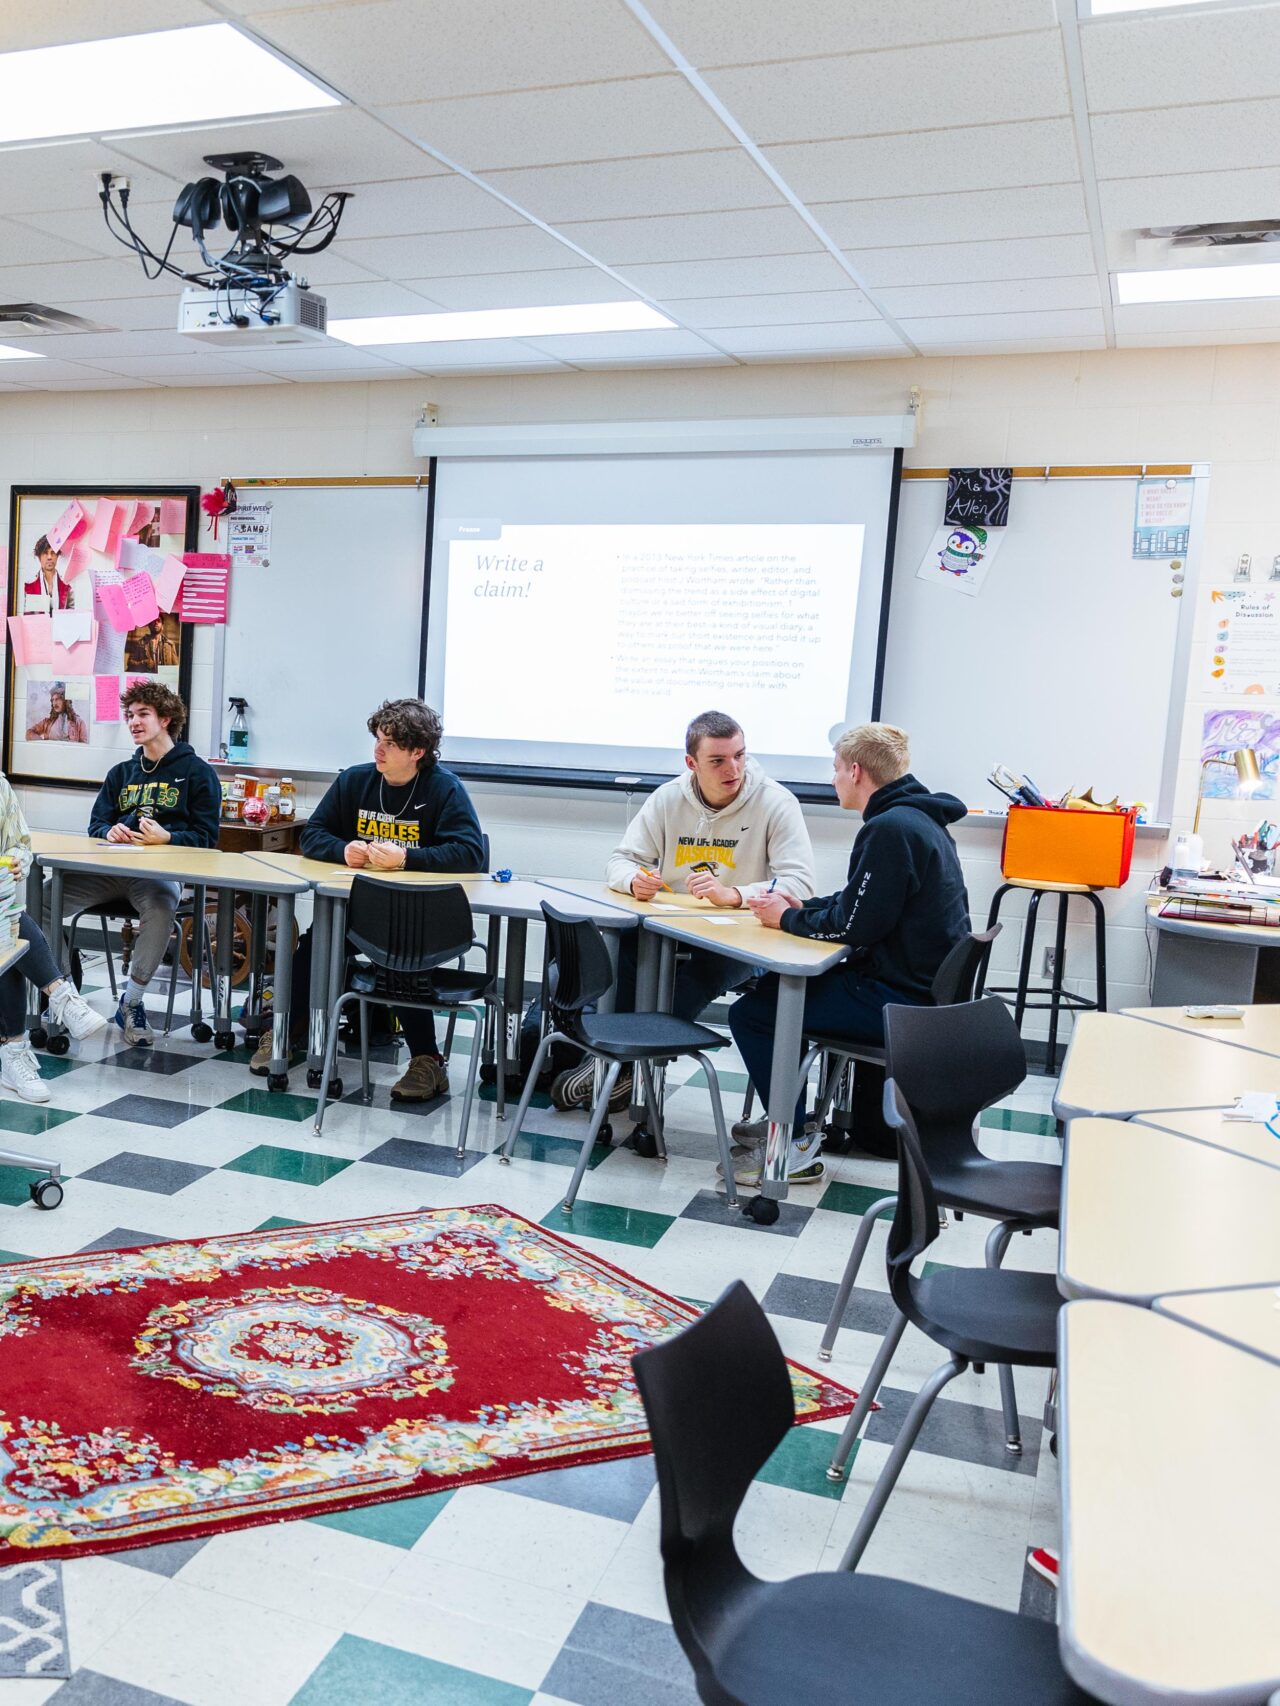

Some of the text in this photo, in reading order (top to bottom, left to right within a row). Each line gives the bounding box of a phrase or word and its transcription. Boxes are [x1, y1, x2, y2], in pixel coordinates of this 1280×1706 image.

[954, 478, 981, 492] Ms
[946, 498, 988, 516] Allen
[665, 553, 684, 561] New
[736, 554, 764, 562] article
[781, 554, 796, 562] the
[477, 554, 544, 572] Write a
[794, 566, 811, 574] and
[795, 577, 816, 585] than
[474, 579, 532, 598] claim!
[790, 588, 821, 599] digital
[797, 612, 819, 620] what
[776, 634, 798, 642] hold
[773, 671, 800, 680] about
[769, 681, 788, 689] with
[357, 818, 420, 841] EAGLES
[678, 836, 694, 846] NEW
[696, 838, 710, 846] LIFE
[858, 871, 871, 896] NEW
[845, 899, 859, 930] LIFE
